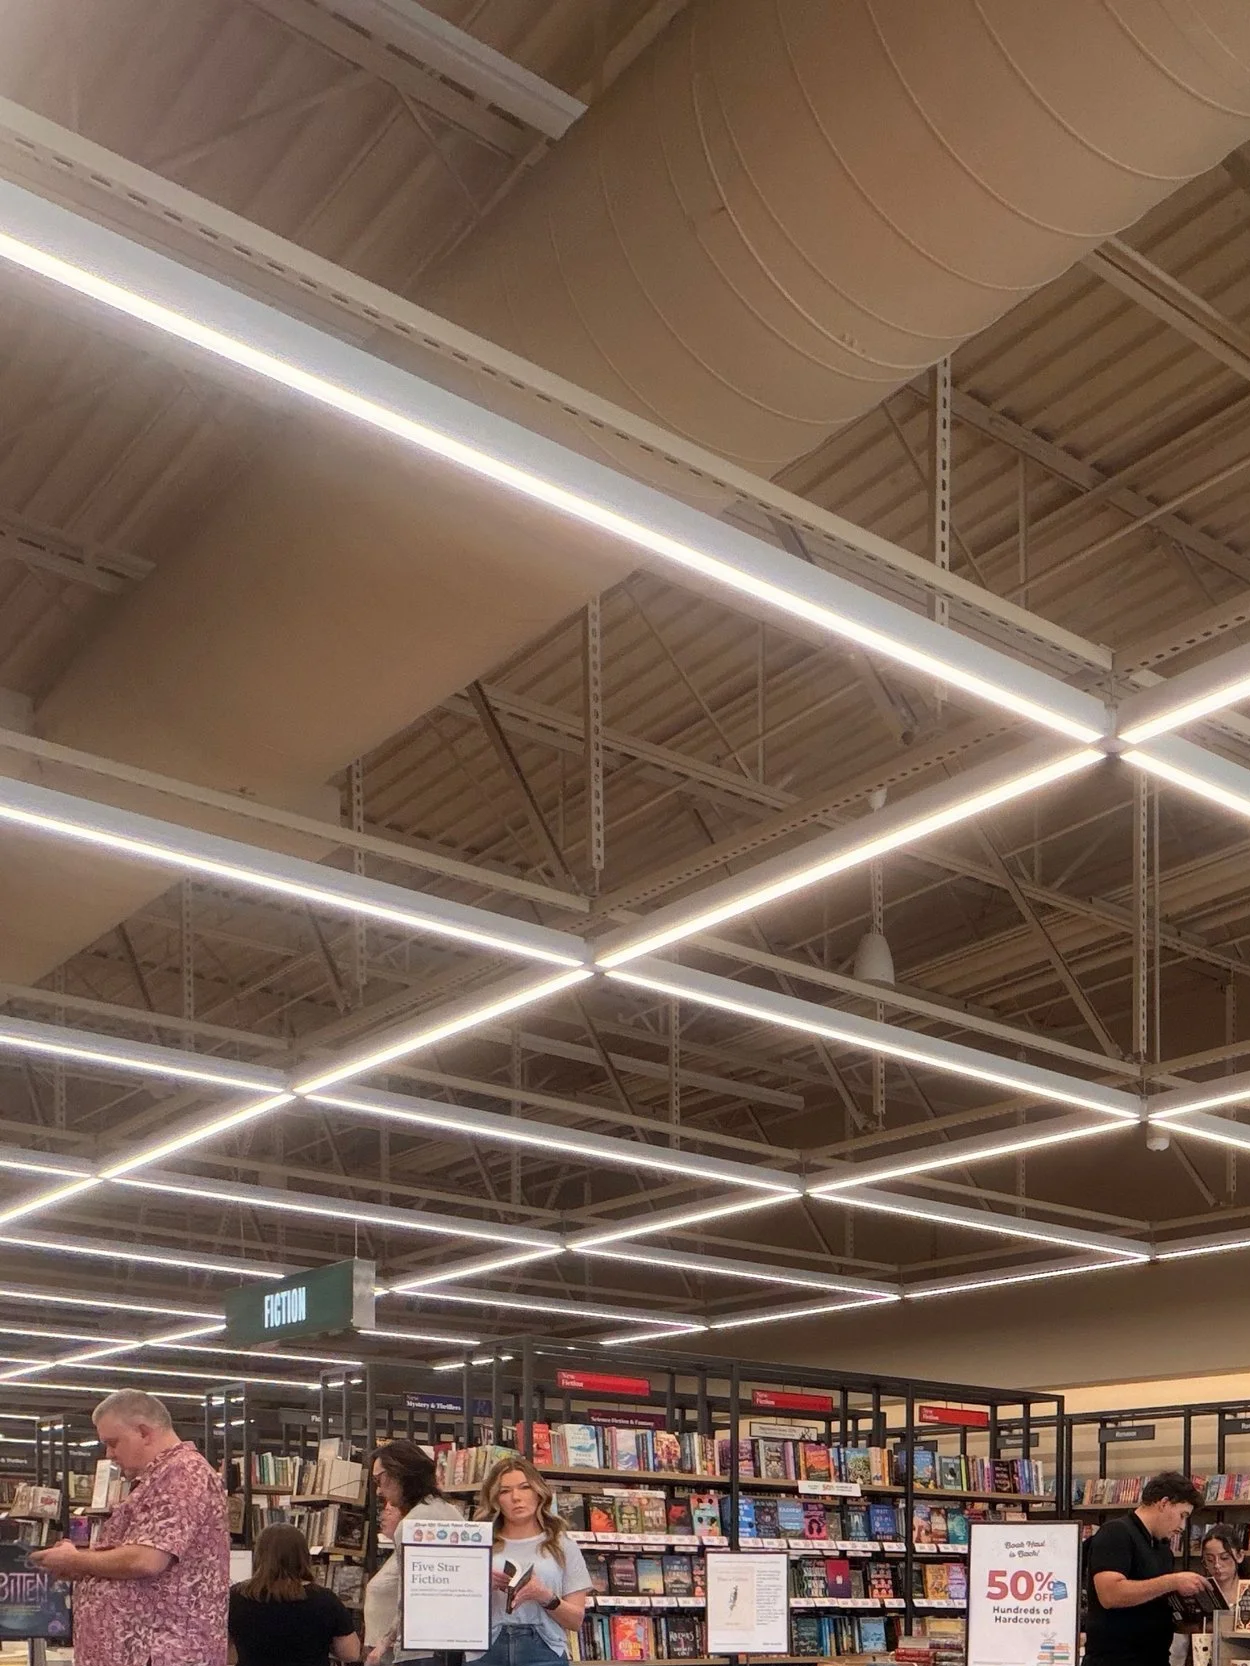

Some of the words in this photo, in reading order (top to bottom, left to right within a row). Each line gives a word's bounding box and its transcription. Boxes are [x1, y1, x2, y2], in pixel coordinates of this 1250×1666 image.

[264, 1287, 306, 1329] FICTION
[561, 1372, 575, 1380] New
[562, 1379, 584, 1388] Fiction
[407, 1401, 429, 1410] Mystery
[437, 1403, 461, 1411] Thrillers
[411, 1561, 435, 1572] Five
[437, 1562, 461, 1573] Star
[411, 1574, 450, 1585] Fiction
[986, 1570, 1055, 1602] 50%
[992, 1606, 1041, 1615] Hundreds
[1043, 1607, 1053, 1615] of
[994, 1615, 1051, 1625] Hardcovers
